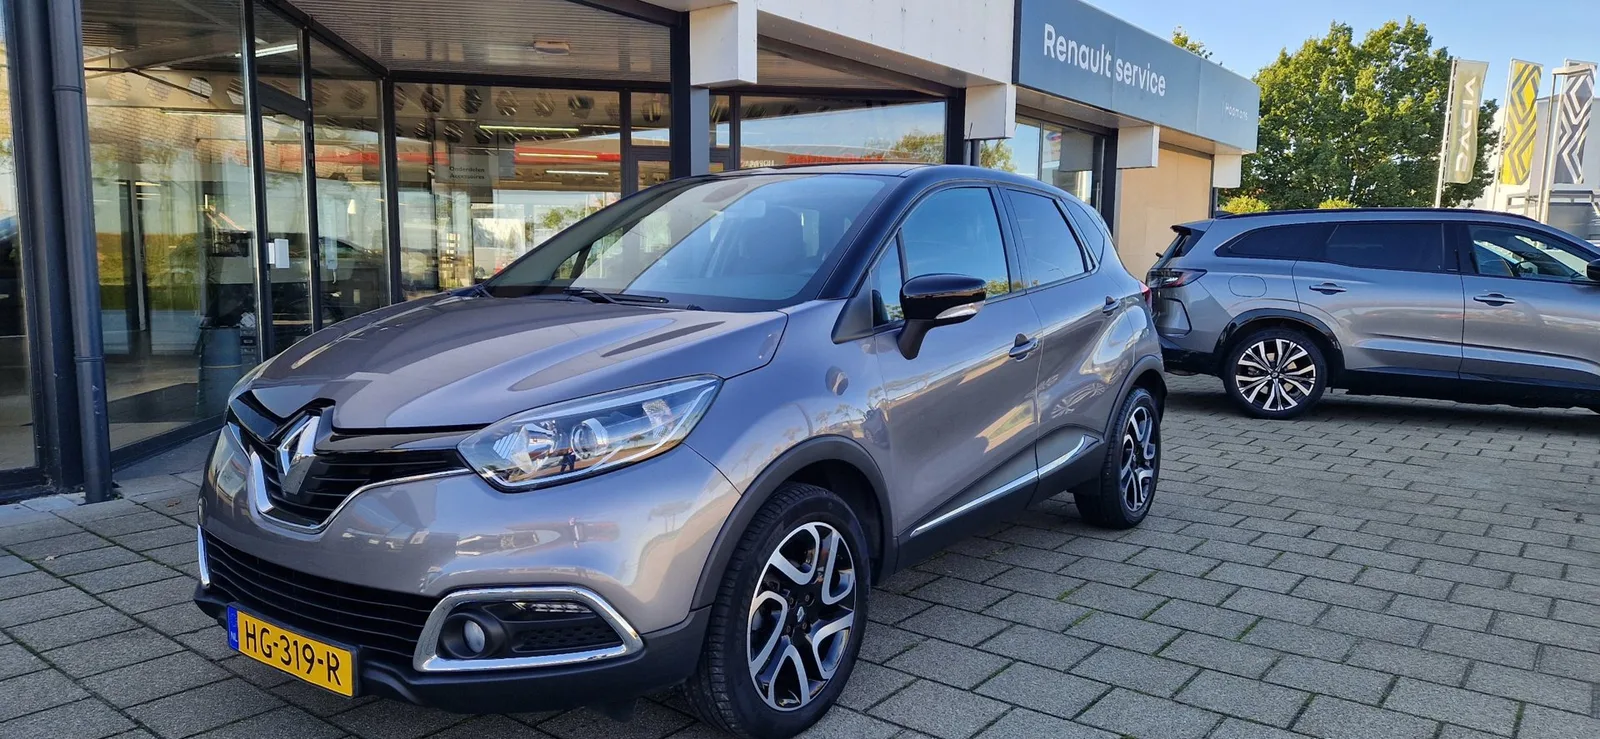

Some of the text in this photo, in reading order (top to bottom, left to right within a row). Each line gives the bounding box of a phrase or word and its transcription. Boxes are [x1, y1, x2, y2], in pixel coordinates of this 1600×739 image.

[1043, 23, 1166, 97] Renault service
[1455, 76, 1476, 172] DACIA
[245, 620, 341, 686] HG-319-R
